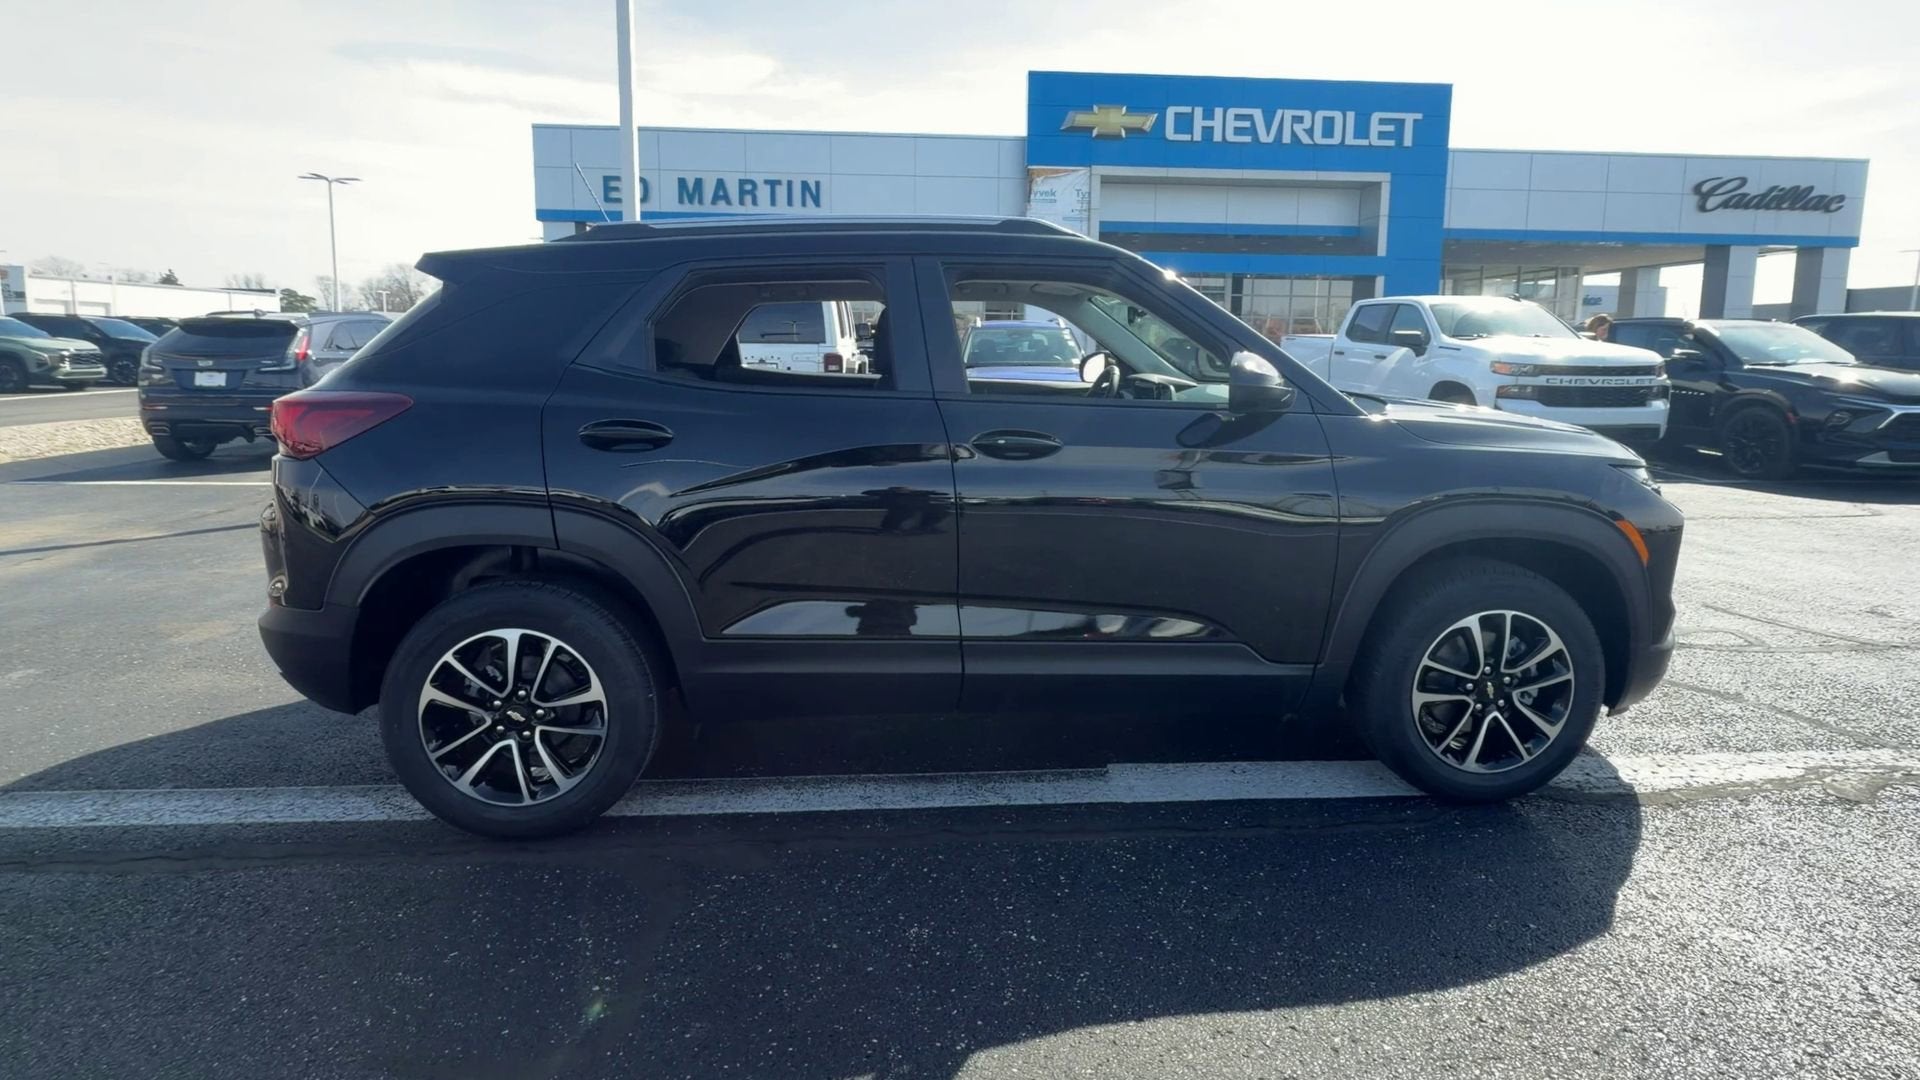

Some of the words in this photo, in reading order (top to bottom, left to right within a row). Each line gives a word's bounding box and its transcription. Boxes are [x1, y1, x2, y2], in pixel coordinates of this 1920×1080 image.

[1165, 105, 1423, 147] CHEVROLET
[677, 177, 822, 208] MARTIN
[1693, 177, 1846, 213] Cadillac
[1546, 377, 1655, 385] CHEVROLET
